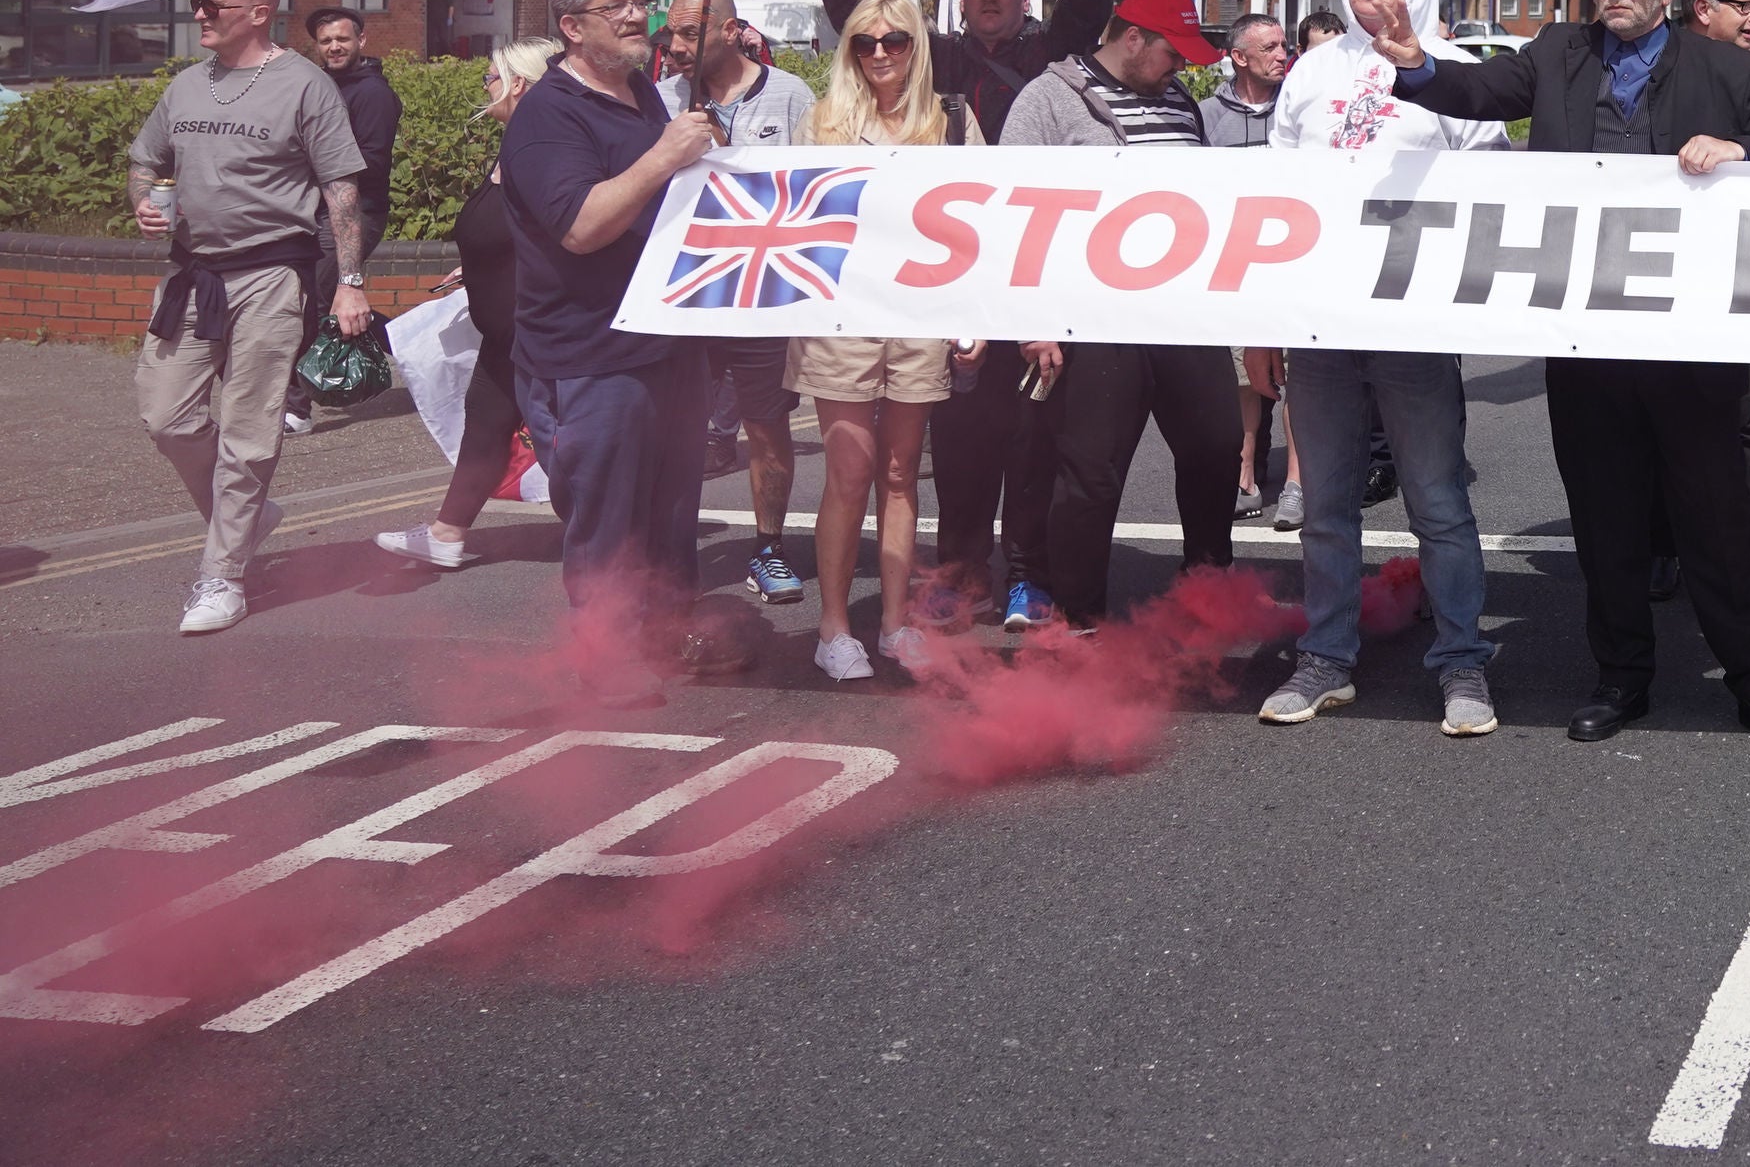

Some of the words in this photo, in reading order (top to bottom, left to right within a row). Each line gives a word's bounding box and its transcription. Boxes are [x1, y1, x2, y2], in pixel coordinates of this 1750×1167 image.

[173, 120, 271, 140] ESSENTIALS
[895, 181, 1321, 293] STOP
[1360, 199, 1681, 312] THE
